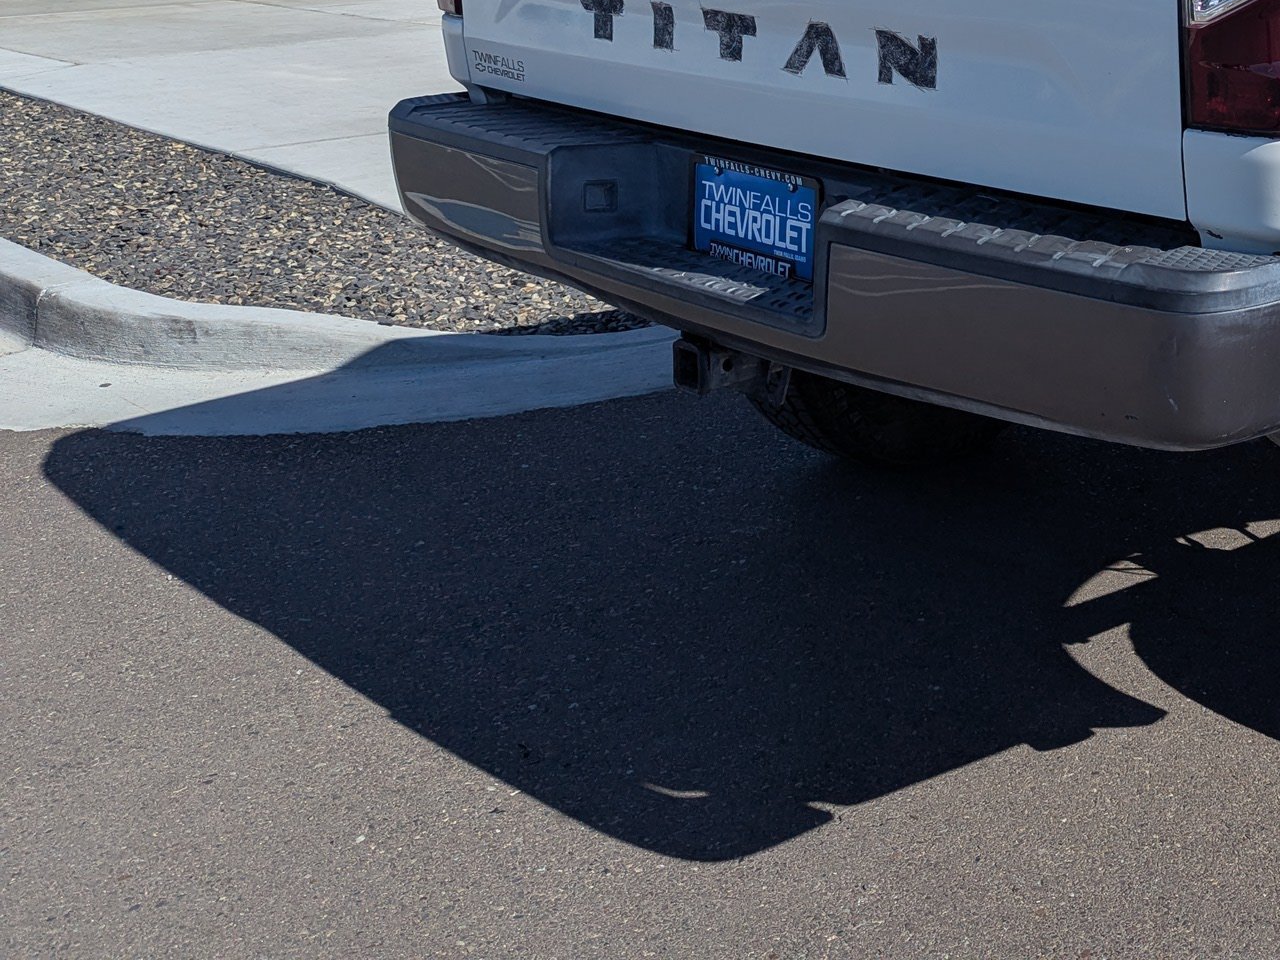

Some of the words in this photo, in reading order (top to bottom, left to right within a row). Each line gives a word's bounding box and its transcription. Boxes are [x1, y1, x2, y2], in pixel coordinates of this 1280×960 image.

[487, 65, 526, 82] CHEVROLET
[704, 156, 804, 186] TWINFALLS-CHEVY.COM
[702, 180, 812, 223] TWINFALLS
[701, 198, 812, 254] CHEVROLET
[732, 248, 792, 279] CHEVROLET
